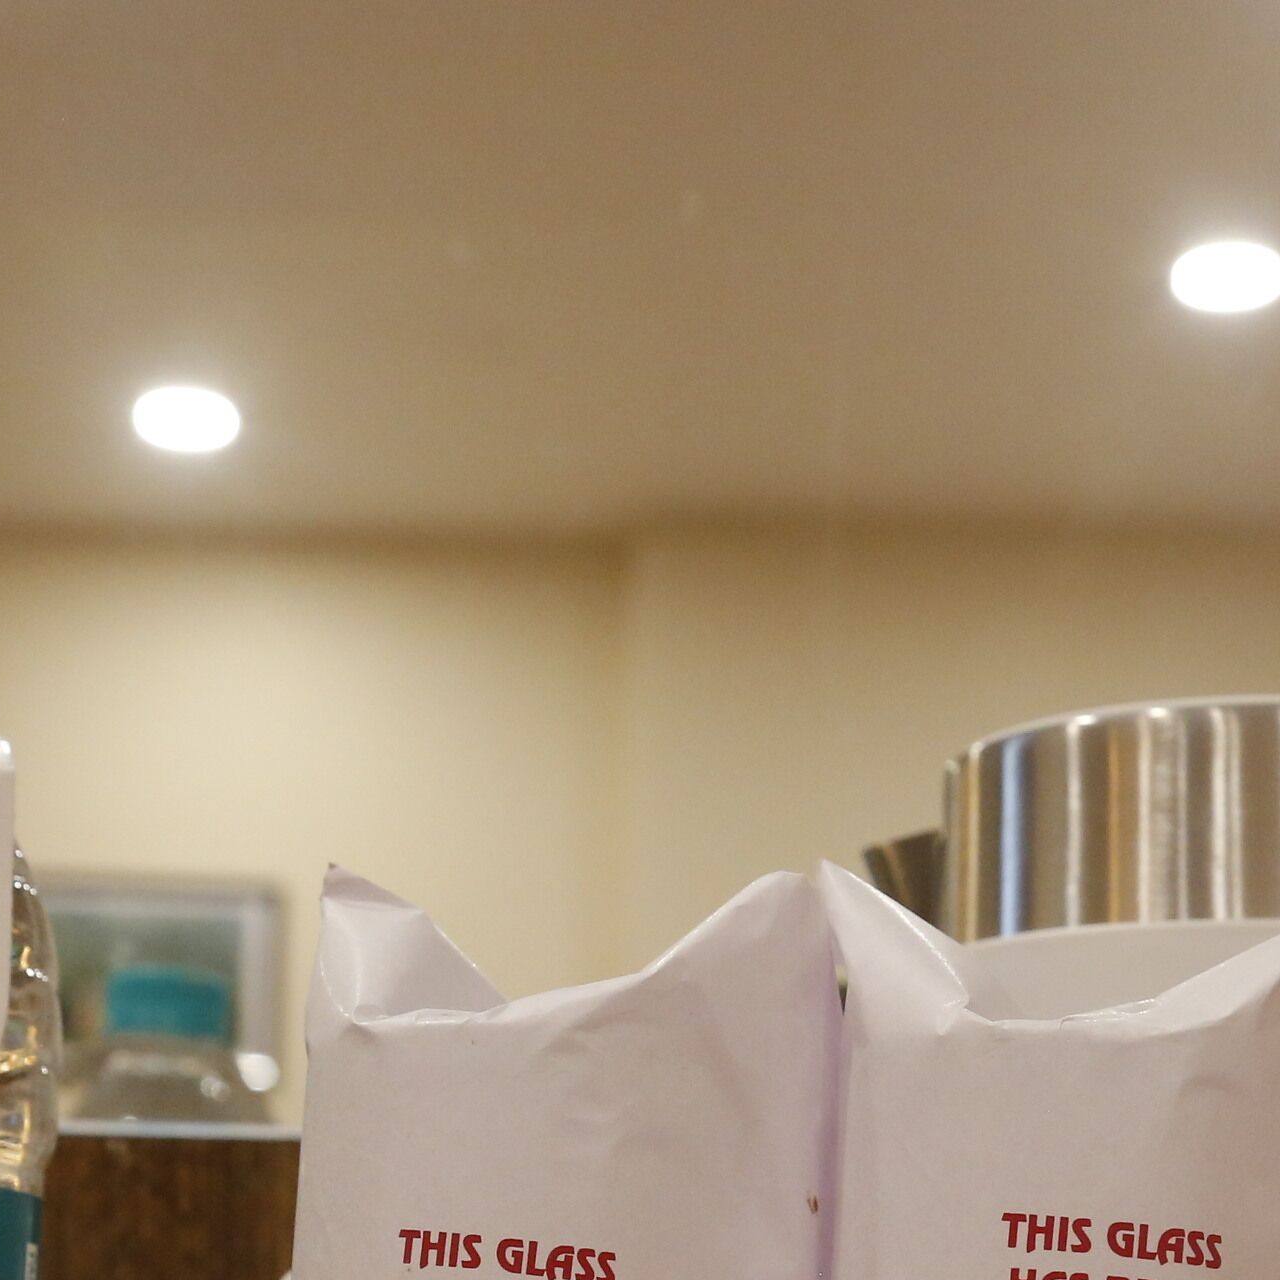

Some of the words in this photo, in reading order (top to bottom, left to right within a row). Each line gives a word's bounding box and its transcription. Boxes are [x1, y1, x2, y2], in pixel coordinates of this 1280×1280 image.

[398, 1229, 482, 1269] THIS
[1001, 1212, 1092, 1254] THIS
[1107, 1222, 1222, 1269] GLASS
